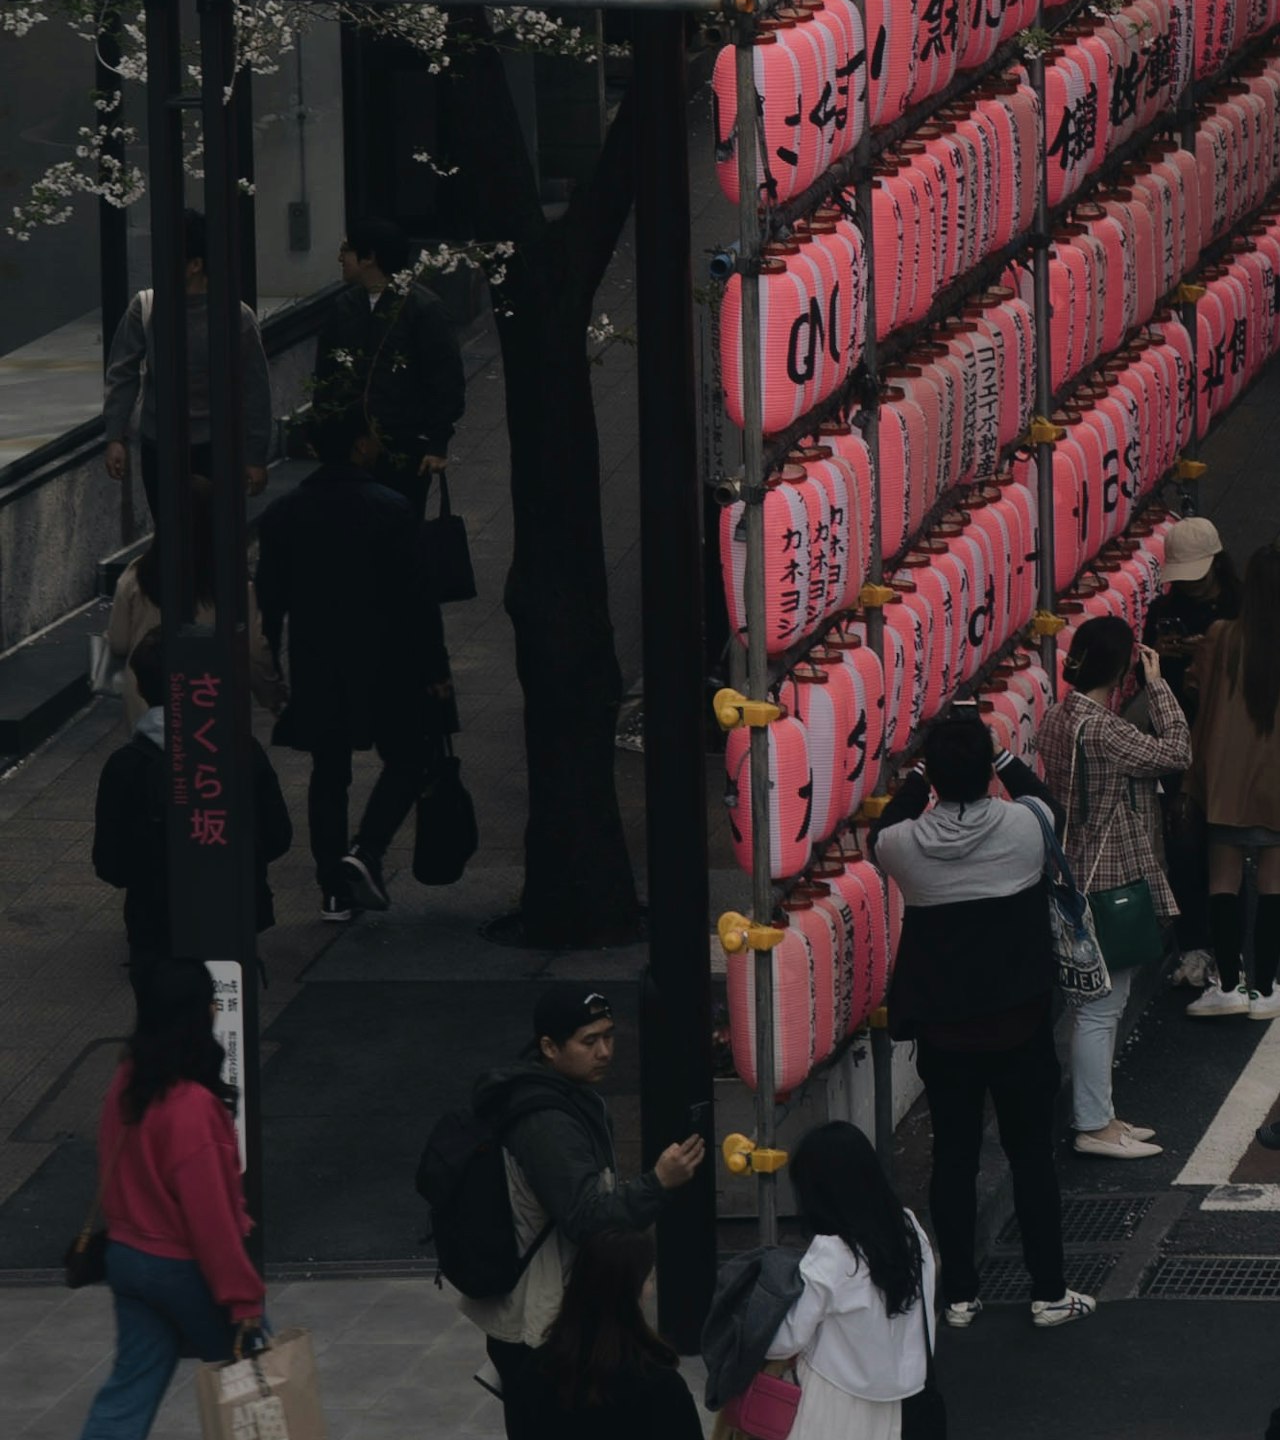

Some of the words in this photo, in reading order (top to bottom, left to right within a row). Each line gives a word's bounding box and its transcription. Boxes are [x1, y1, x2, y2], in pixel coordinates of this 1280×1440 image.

[777, 527, 801, 640] カネヨシ
[804, 520, 829, 626] カネヨシ
[825, 504, 844, 608] カネヨシ
[189, 672, 228, 846] さくら坂
